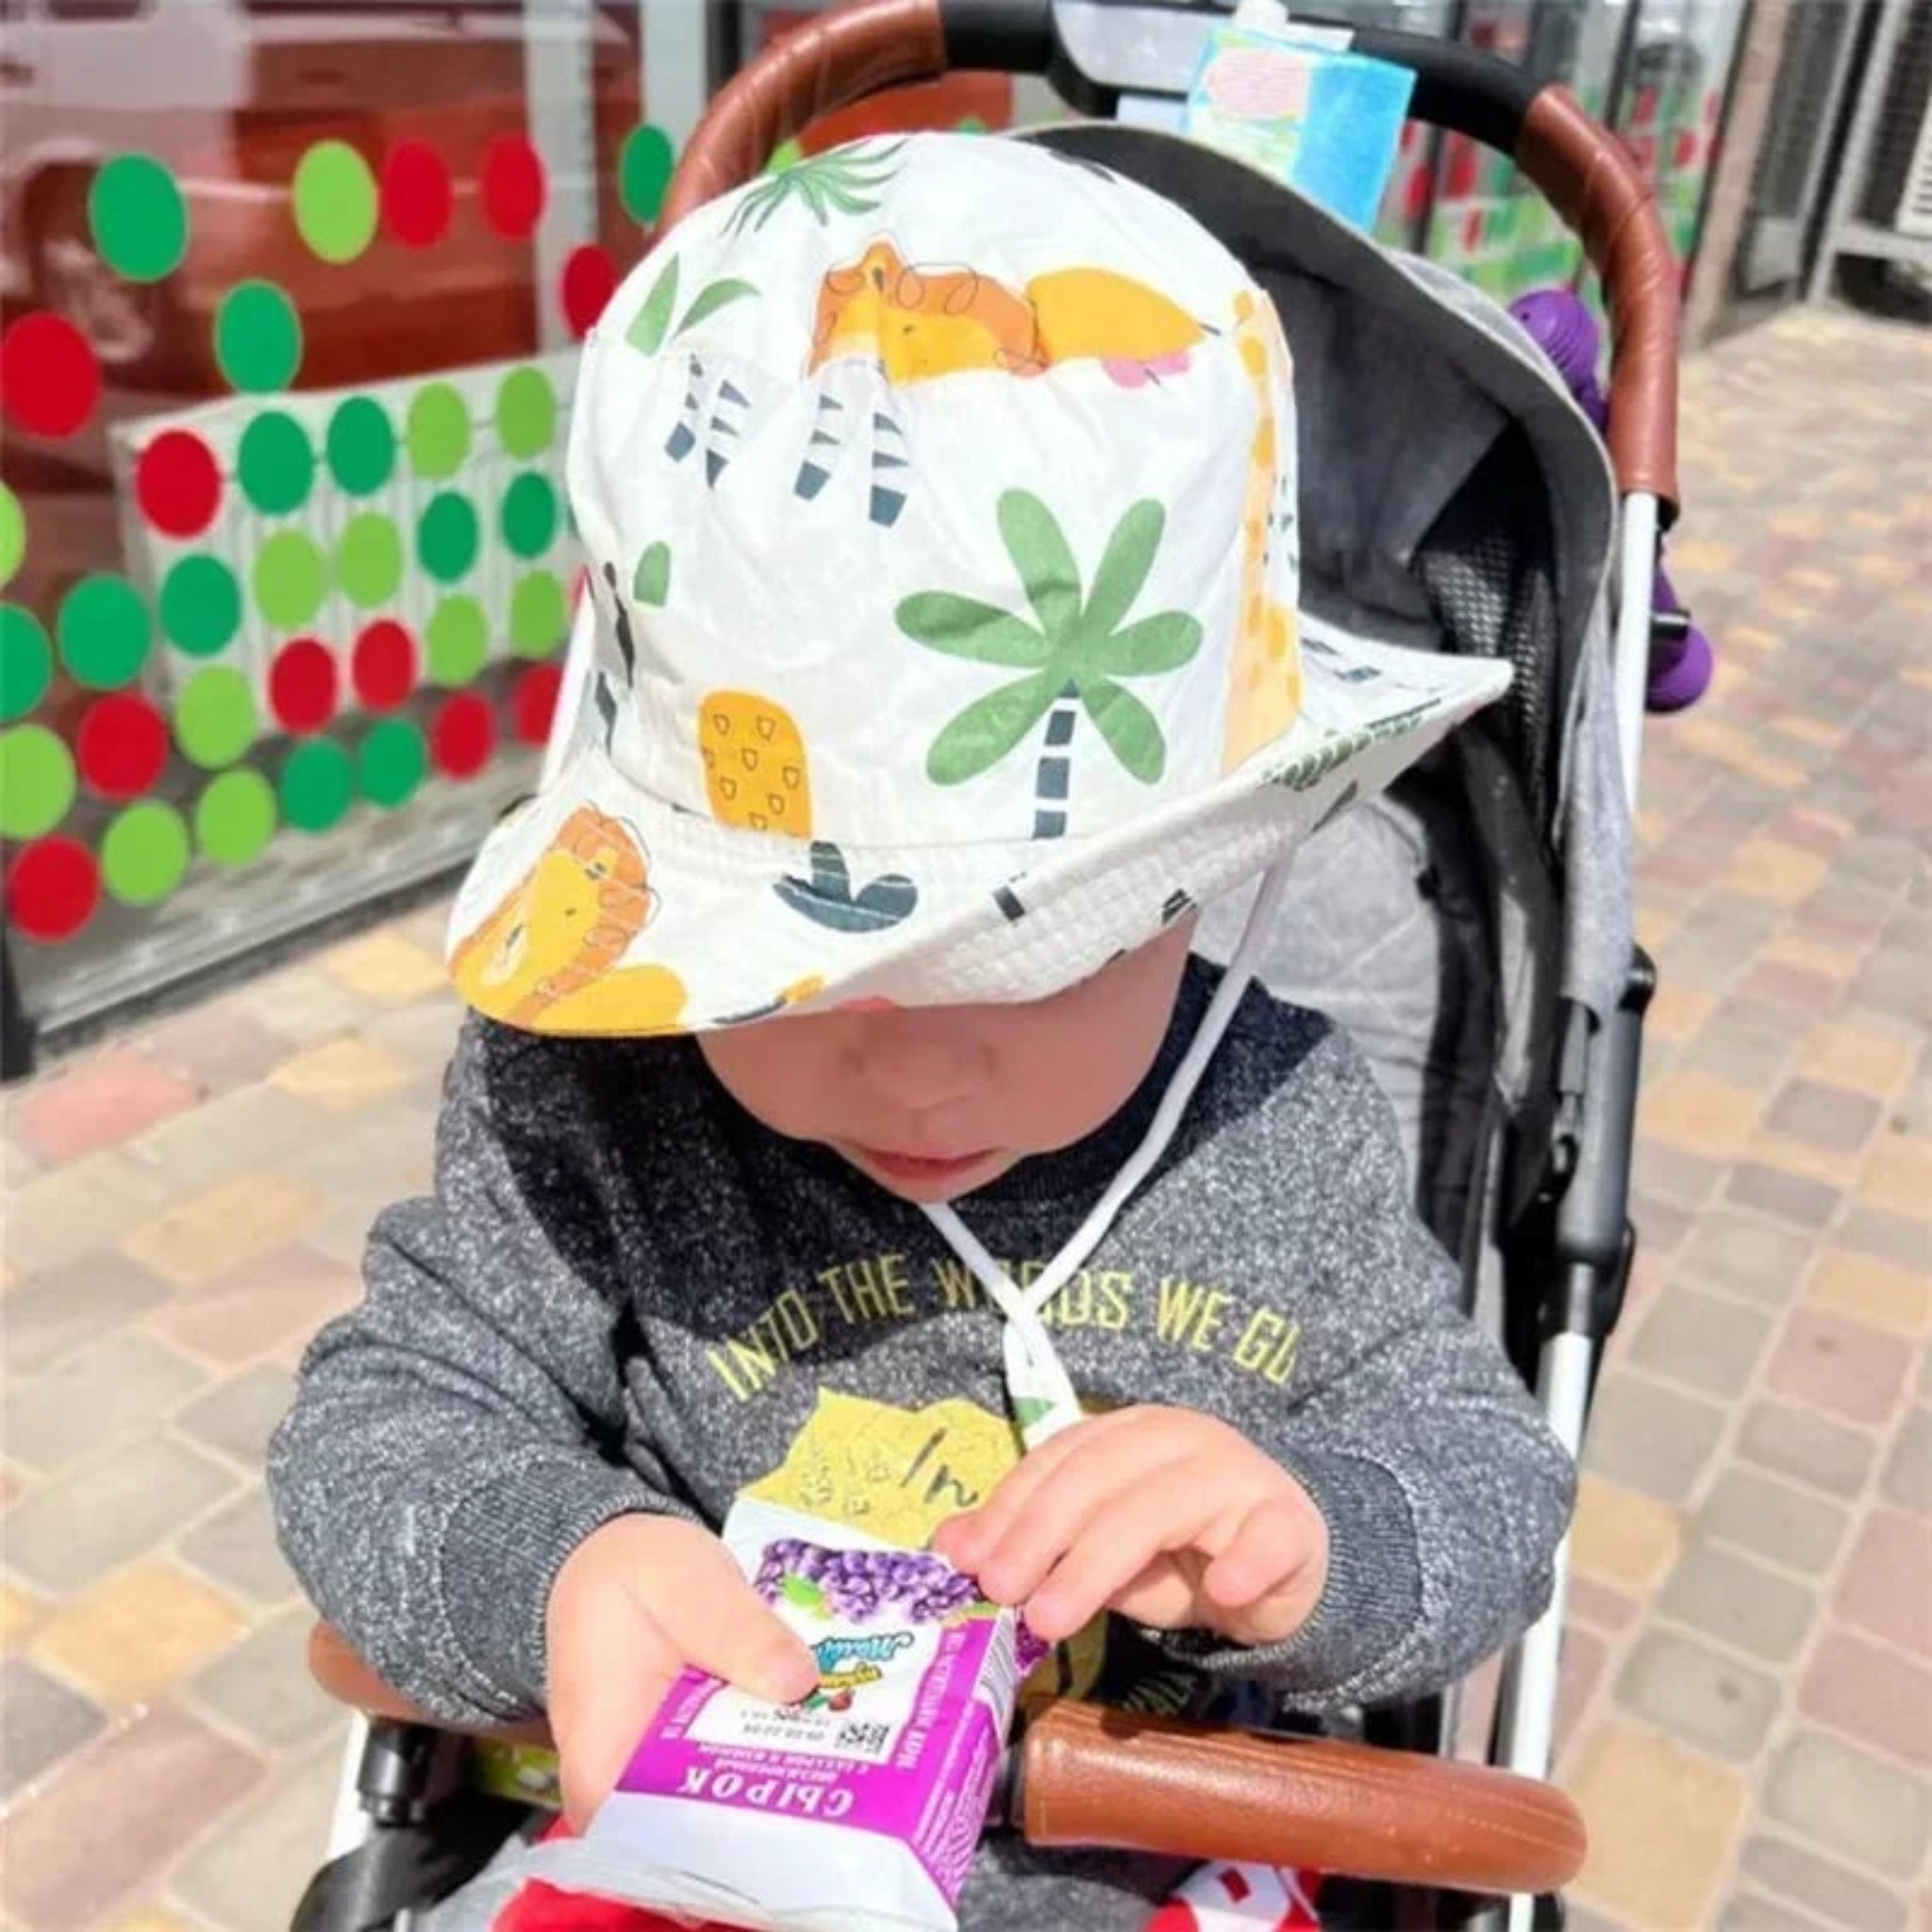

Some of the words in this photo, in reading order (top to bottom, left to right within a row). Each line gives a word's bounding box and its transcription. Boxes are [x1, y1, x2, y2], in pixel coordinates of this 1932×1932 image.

[707, 1287, 819, 1402] INTO
[817, 1253, 915, 1324] THE
[929, 1256, 1133, 1330] WDS
[1157, 1274, 1237, 1352] WE
[675, 1765, 855, 1818] СЫРОК
